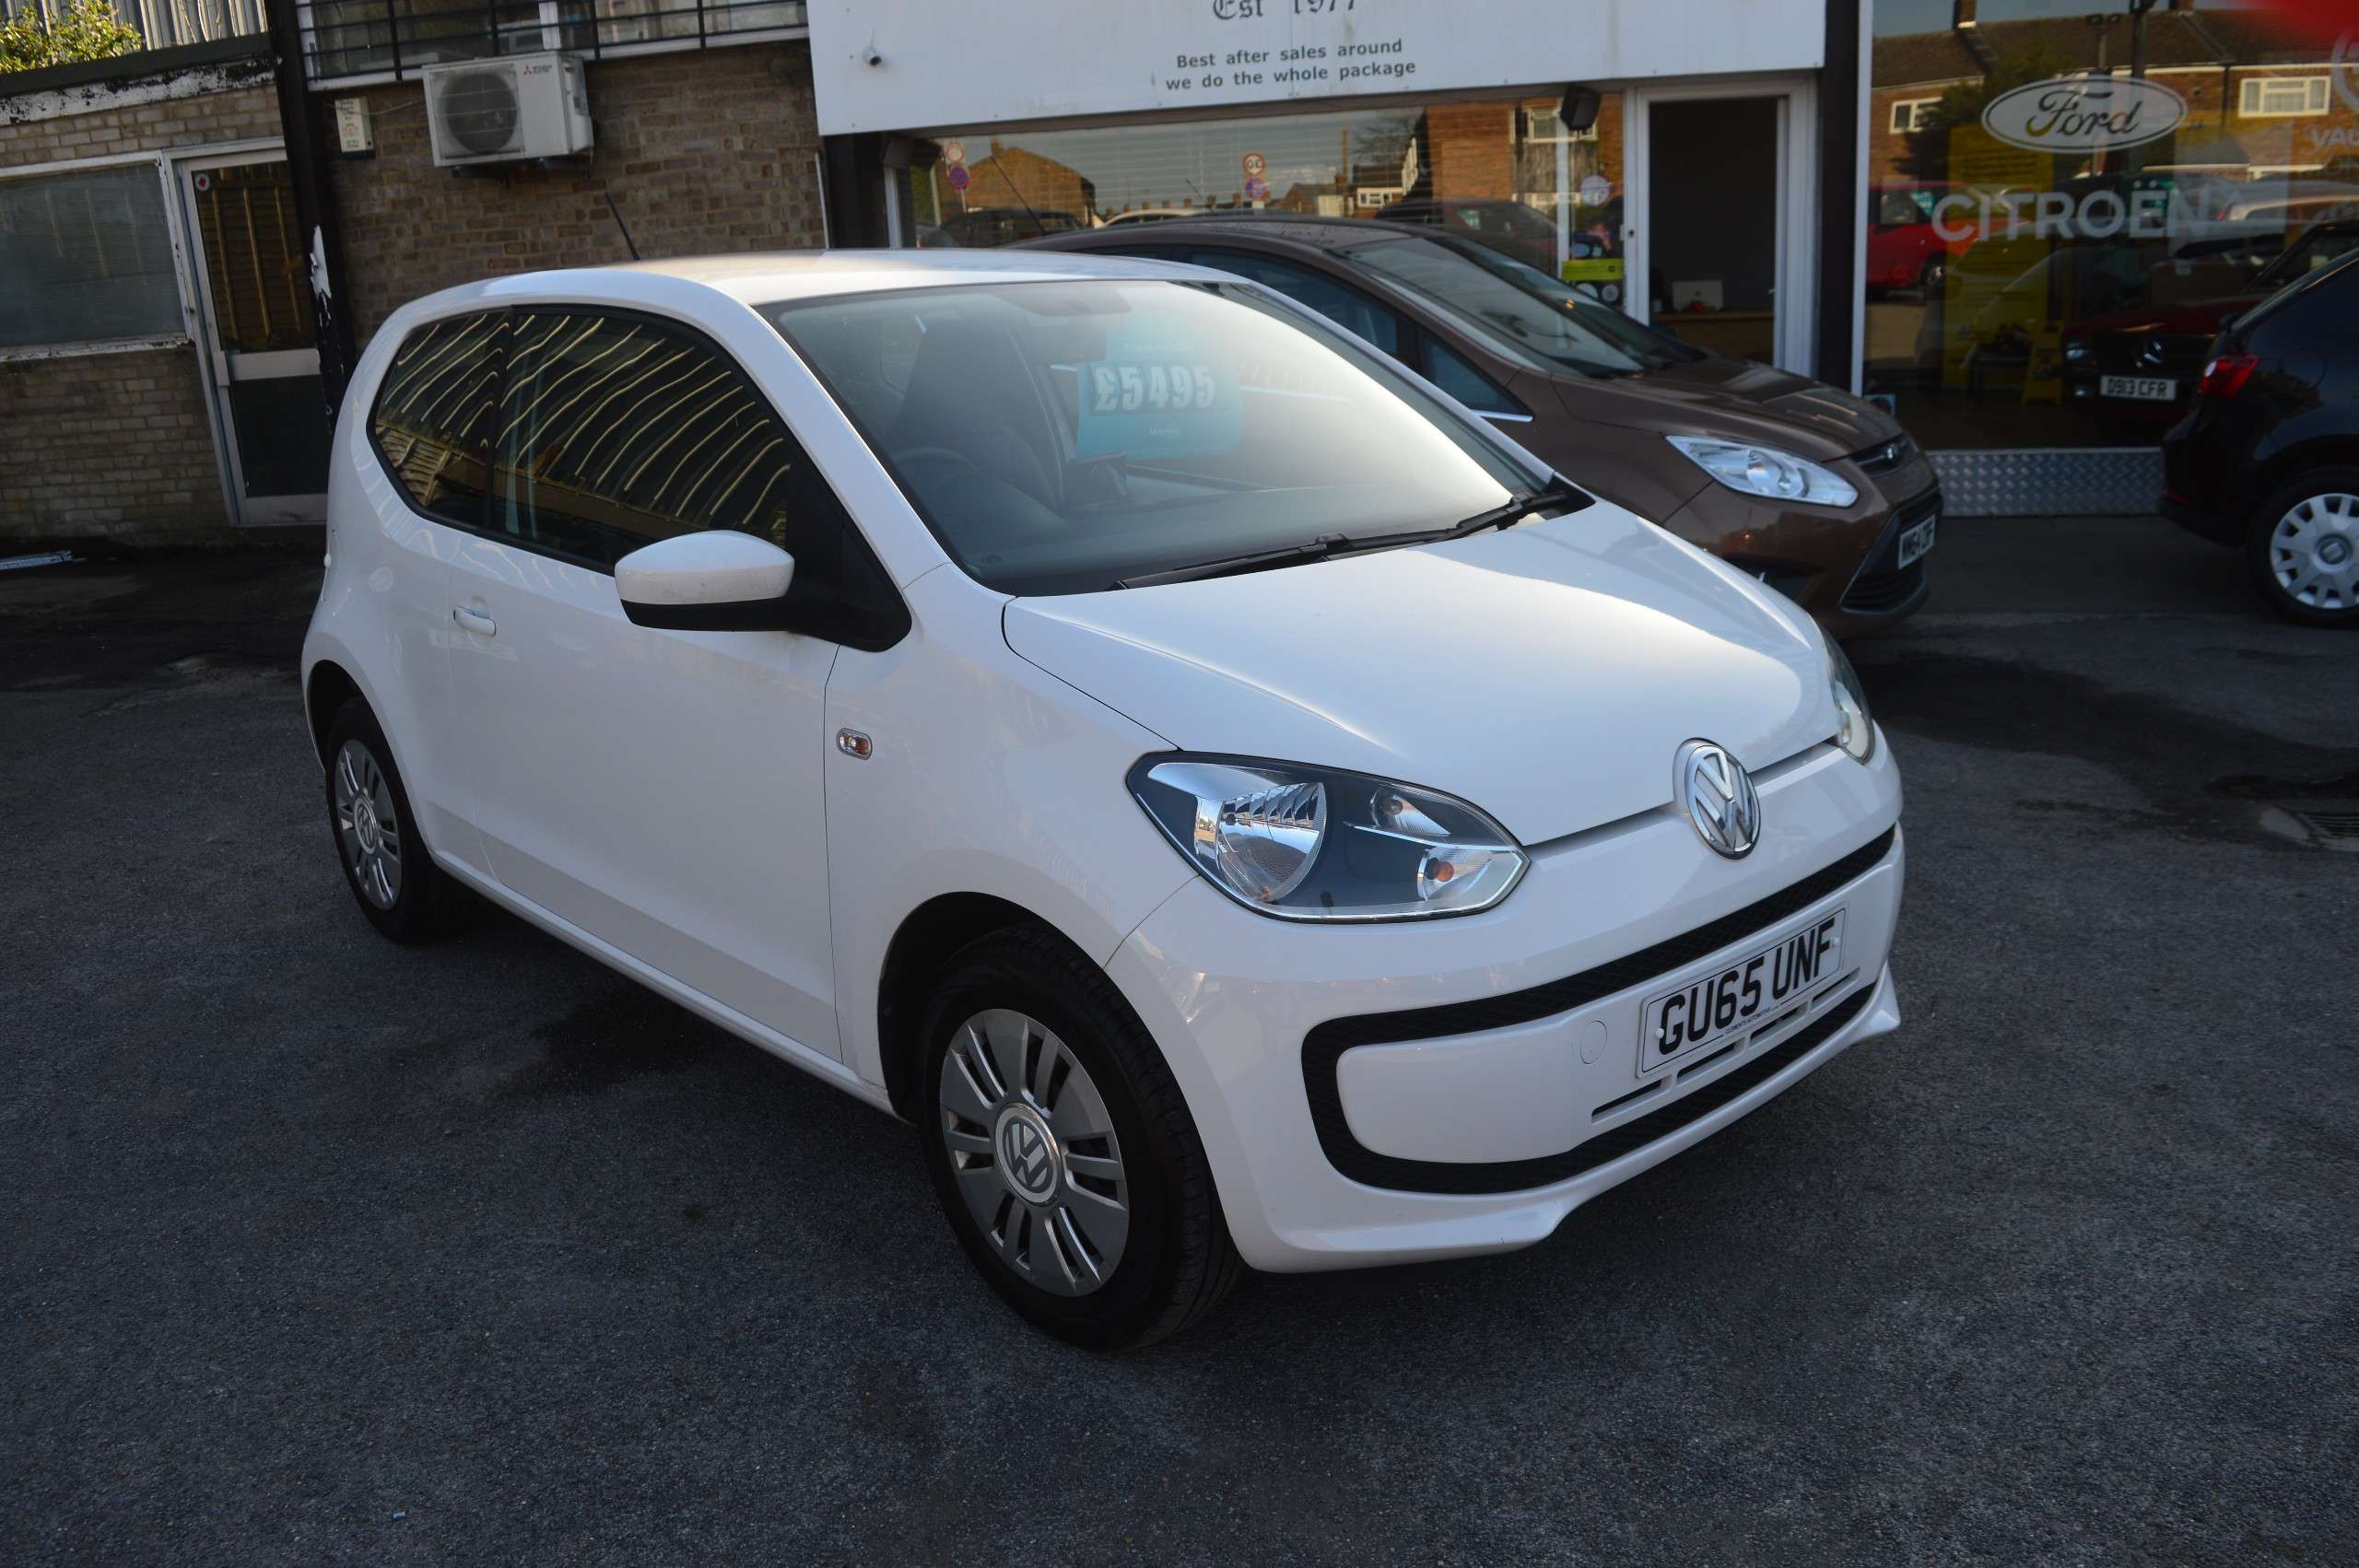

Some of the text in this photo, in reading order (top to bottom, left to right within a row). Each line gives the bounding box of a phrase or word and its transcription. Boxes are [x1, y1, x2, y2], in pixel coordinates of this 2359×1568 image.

[1166, 62, 1416, 90] we do the whole package
[1177, 38, 1402, 68] Best after sales around
[2025, 88, 2144, 137] Ford
[1931, 181, 2212, 242] CITROËN
[1093, 365, 1216, 412] £5495
[1659, 917, 1836, 1056] GU65 UNF
